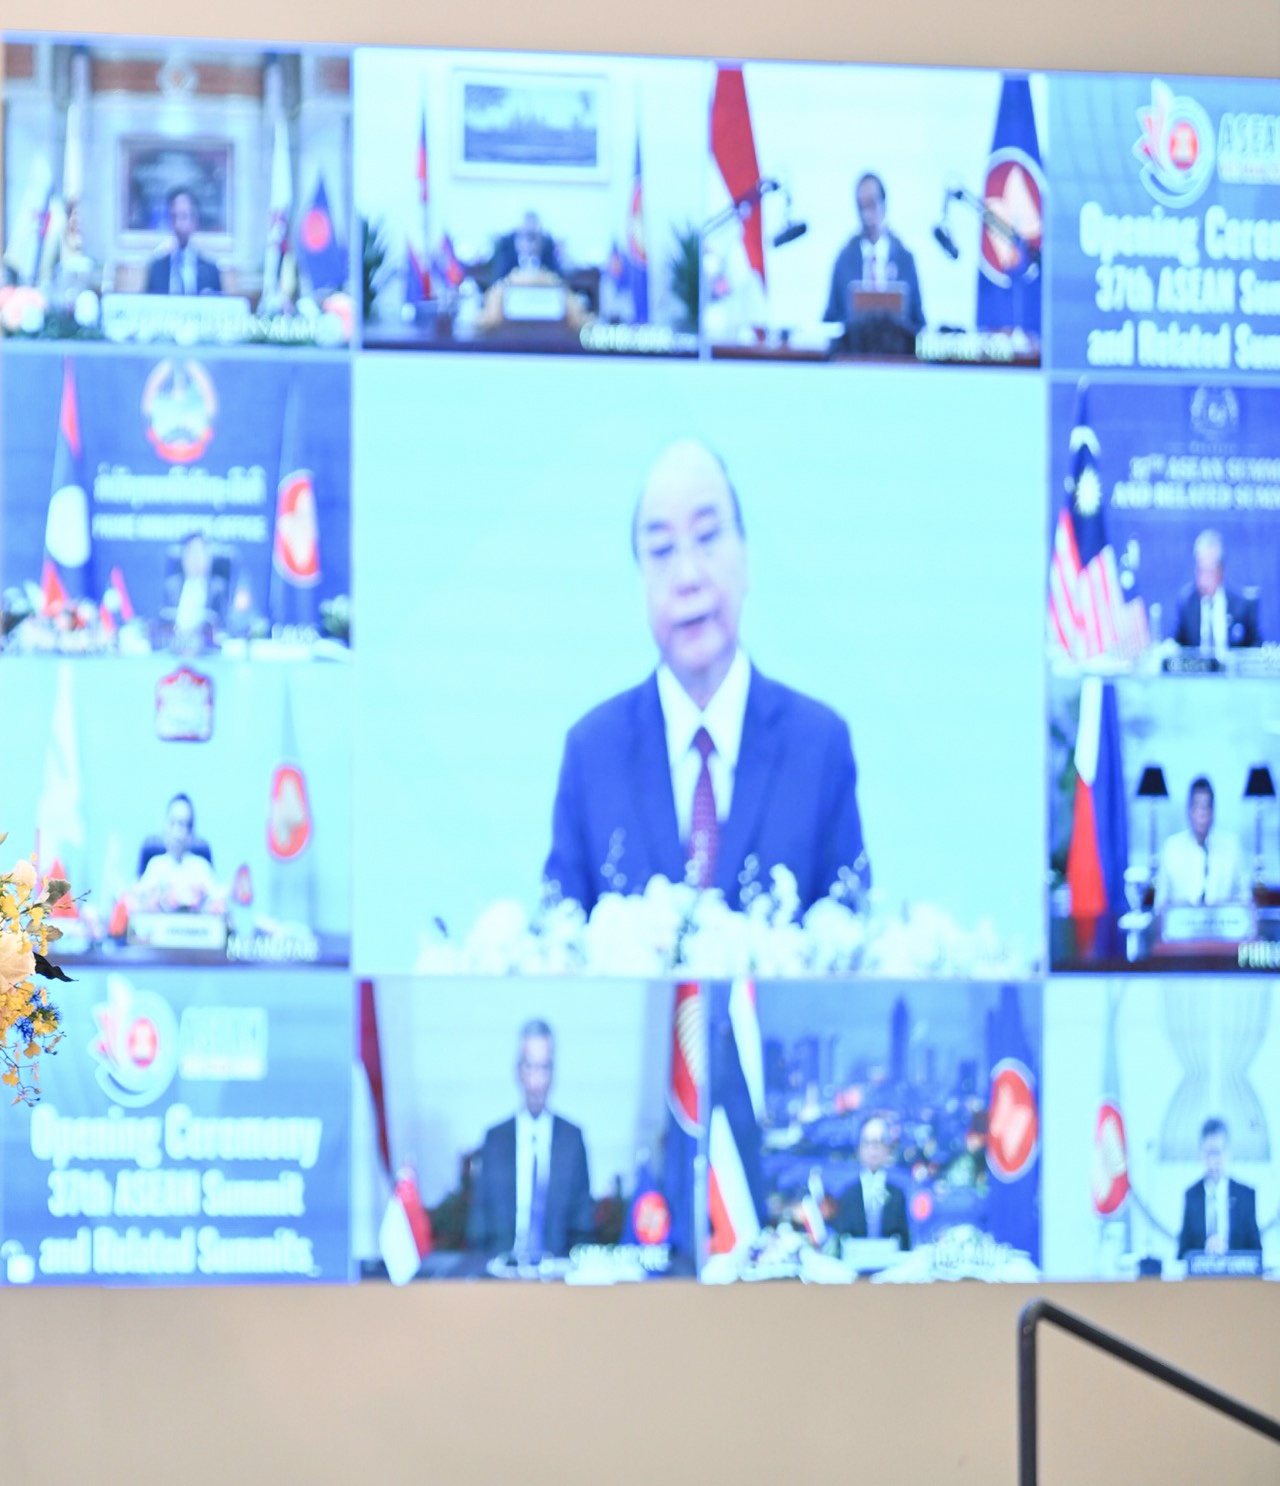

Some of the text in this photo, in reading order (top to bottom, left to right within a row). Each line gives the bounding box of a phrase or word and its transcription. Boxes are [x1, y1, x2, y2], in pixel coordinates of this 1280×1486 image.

[1080, 202, 1200, 266] Opening
[1096, 265, 1154, 313] 37th
[1157, 266, 1236, 314] ASEAN
[1087, 321, 1134, 367] and
[1137, 321, 1232, 369] Related
[31, 1104, 322, 1169] Opening Ceremony
[48, 1169, 305, 1217] 37th ASEAN Summit
[39, 1227, 92, 1274] and
[93, 1227, 196, 1274] Related
